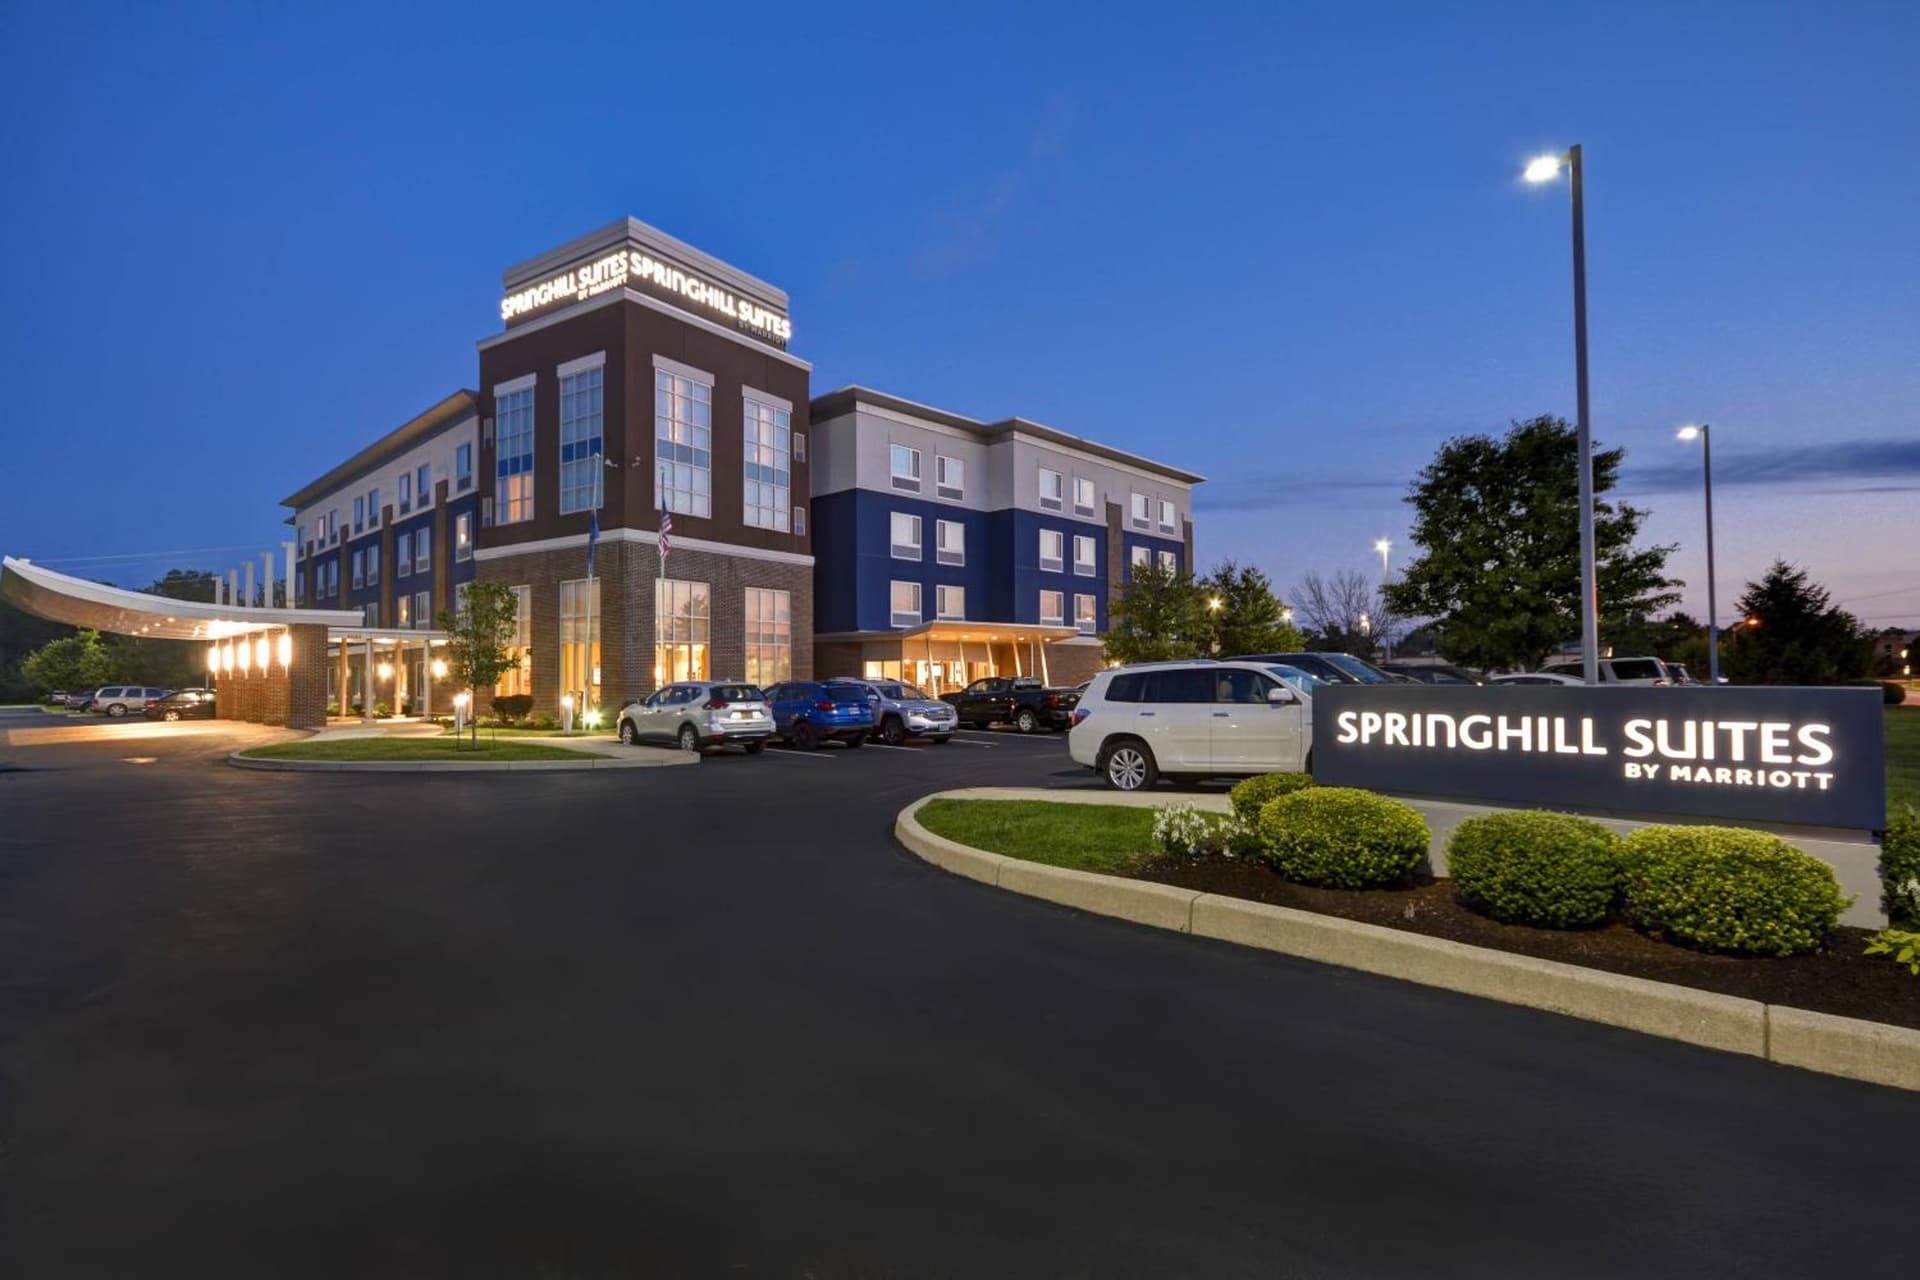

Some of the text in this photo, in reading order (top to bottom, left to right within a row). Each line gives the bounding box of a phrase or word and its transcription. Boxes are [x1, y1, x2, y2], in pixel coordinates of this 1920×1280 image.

[501, 251, 628, 320] SPRINGHILL SUITES
[630, 251, 792, 340] SPRINGHILL SUITES
[1337, 711, 1834, 766] SPRINGHILL SUITES
[1624, 762, 1834, 790] BY MARRIOTT
